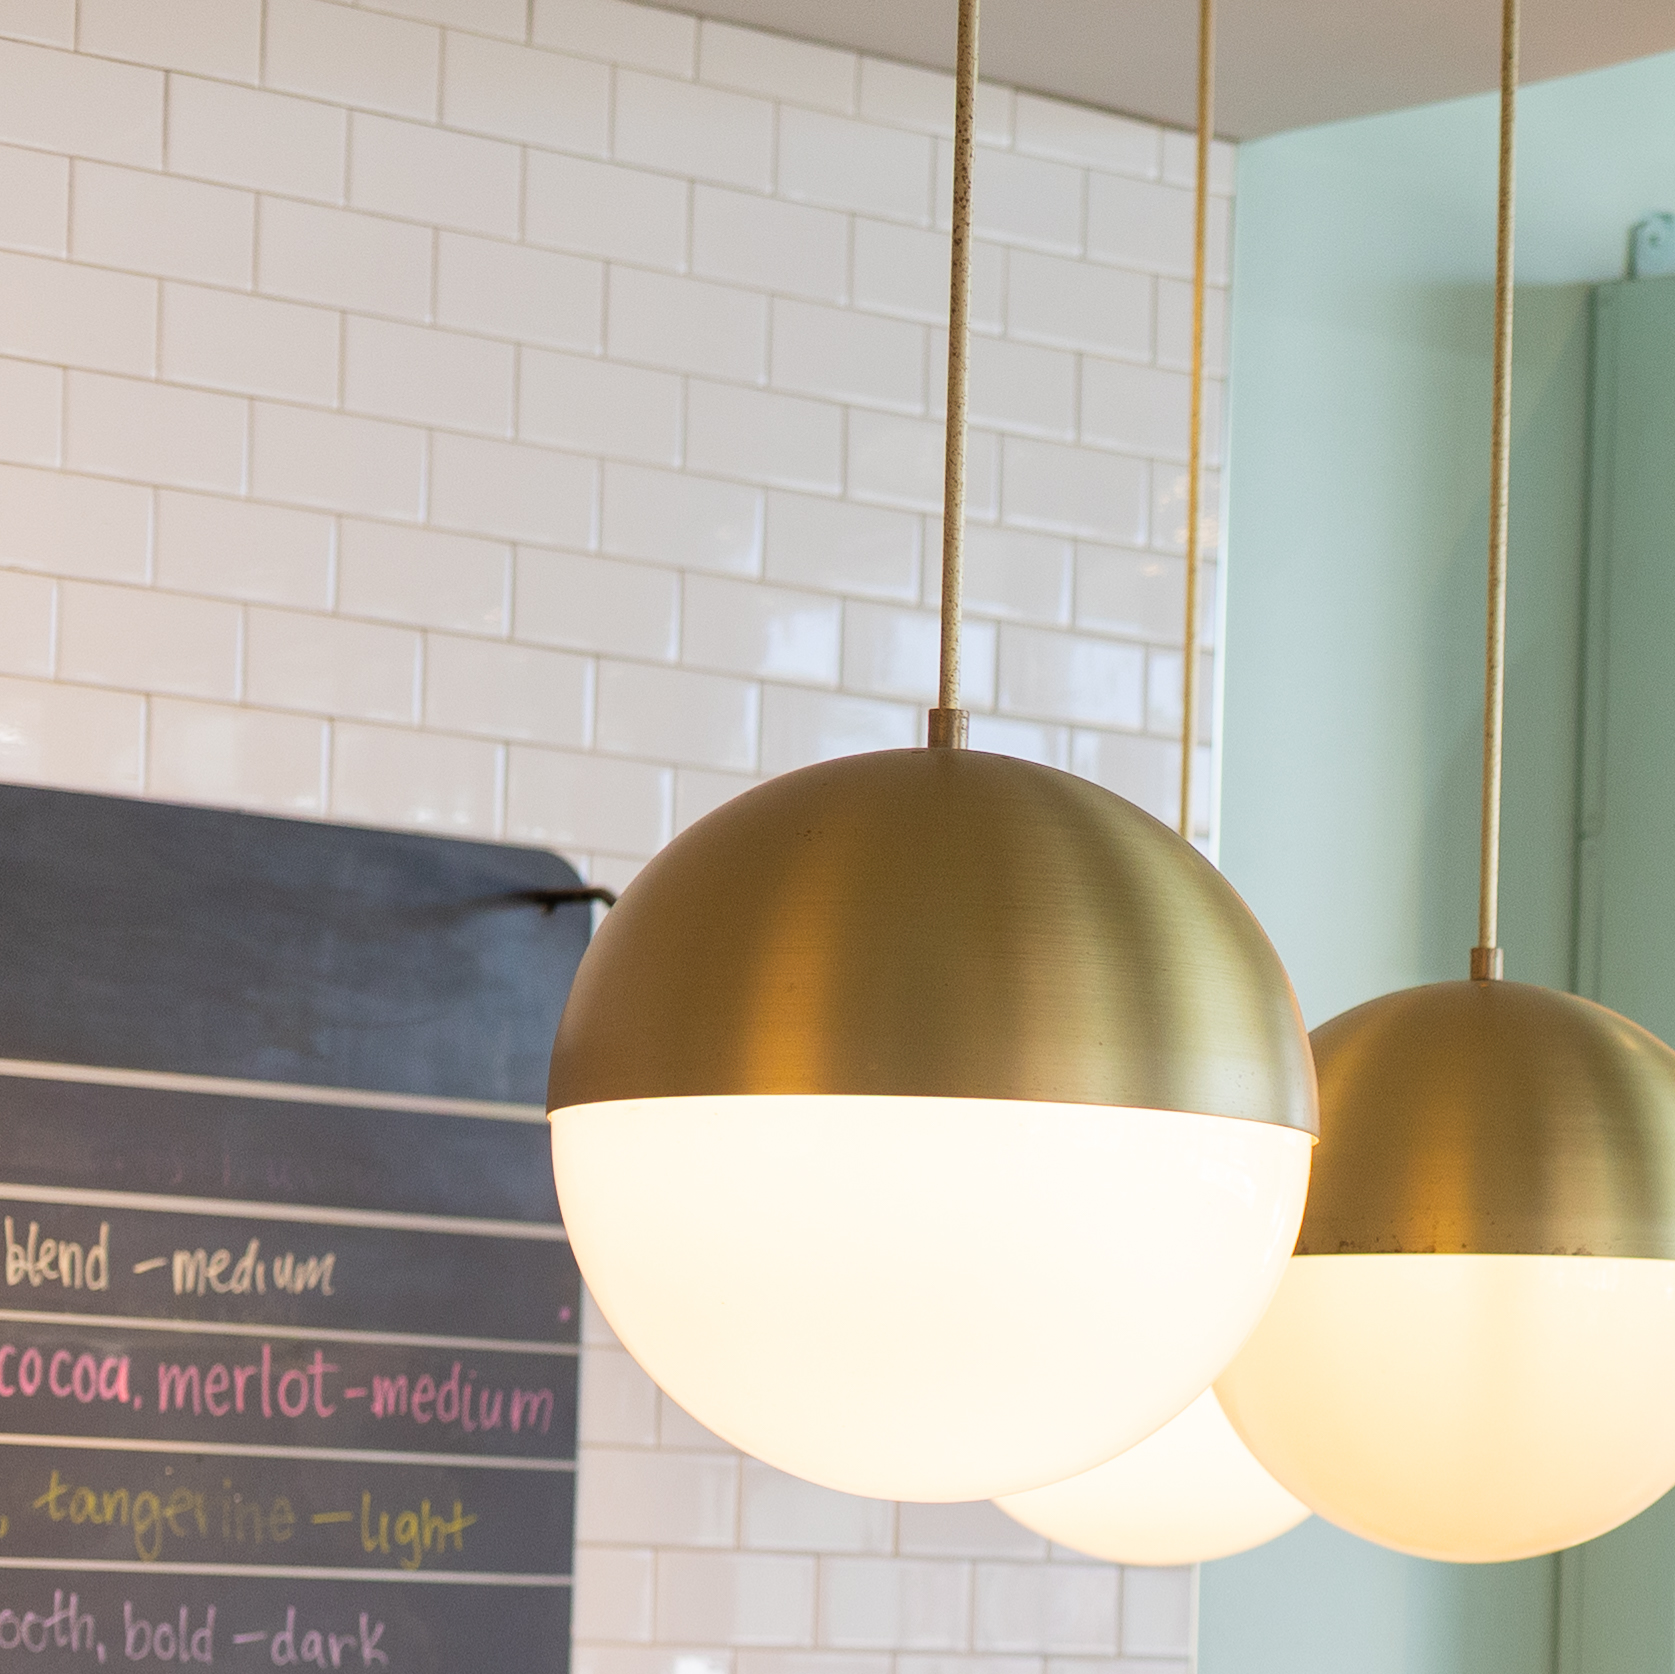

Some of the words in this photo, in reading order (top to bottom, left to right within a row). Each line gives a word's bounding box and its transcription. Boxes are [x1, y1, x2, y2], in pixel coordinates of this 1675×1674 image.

[4, 1215, 109, 1292] blend
[34, 1469, 295, 1562] tangerine
[124, 1600, 216, 1663] bold
